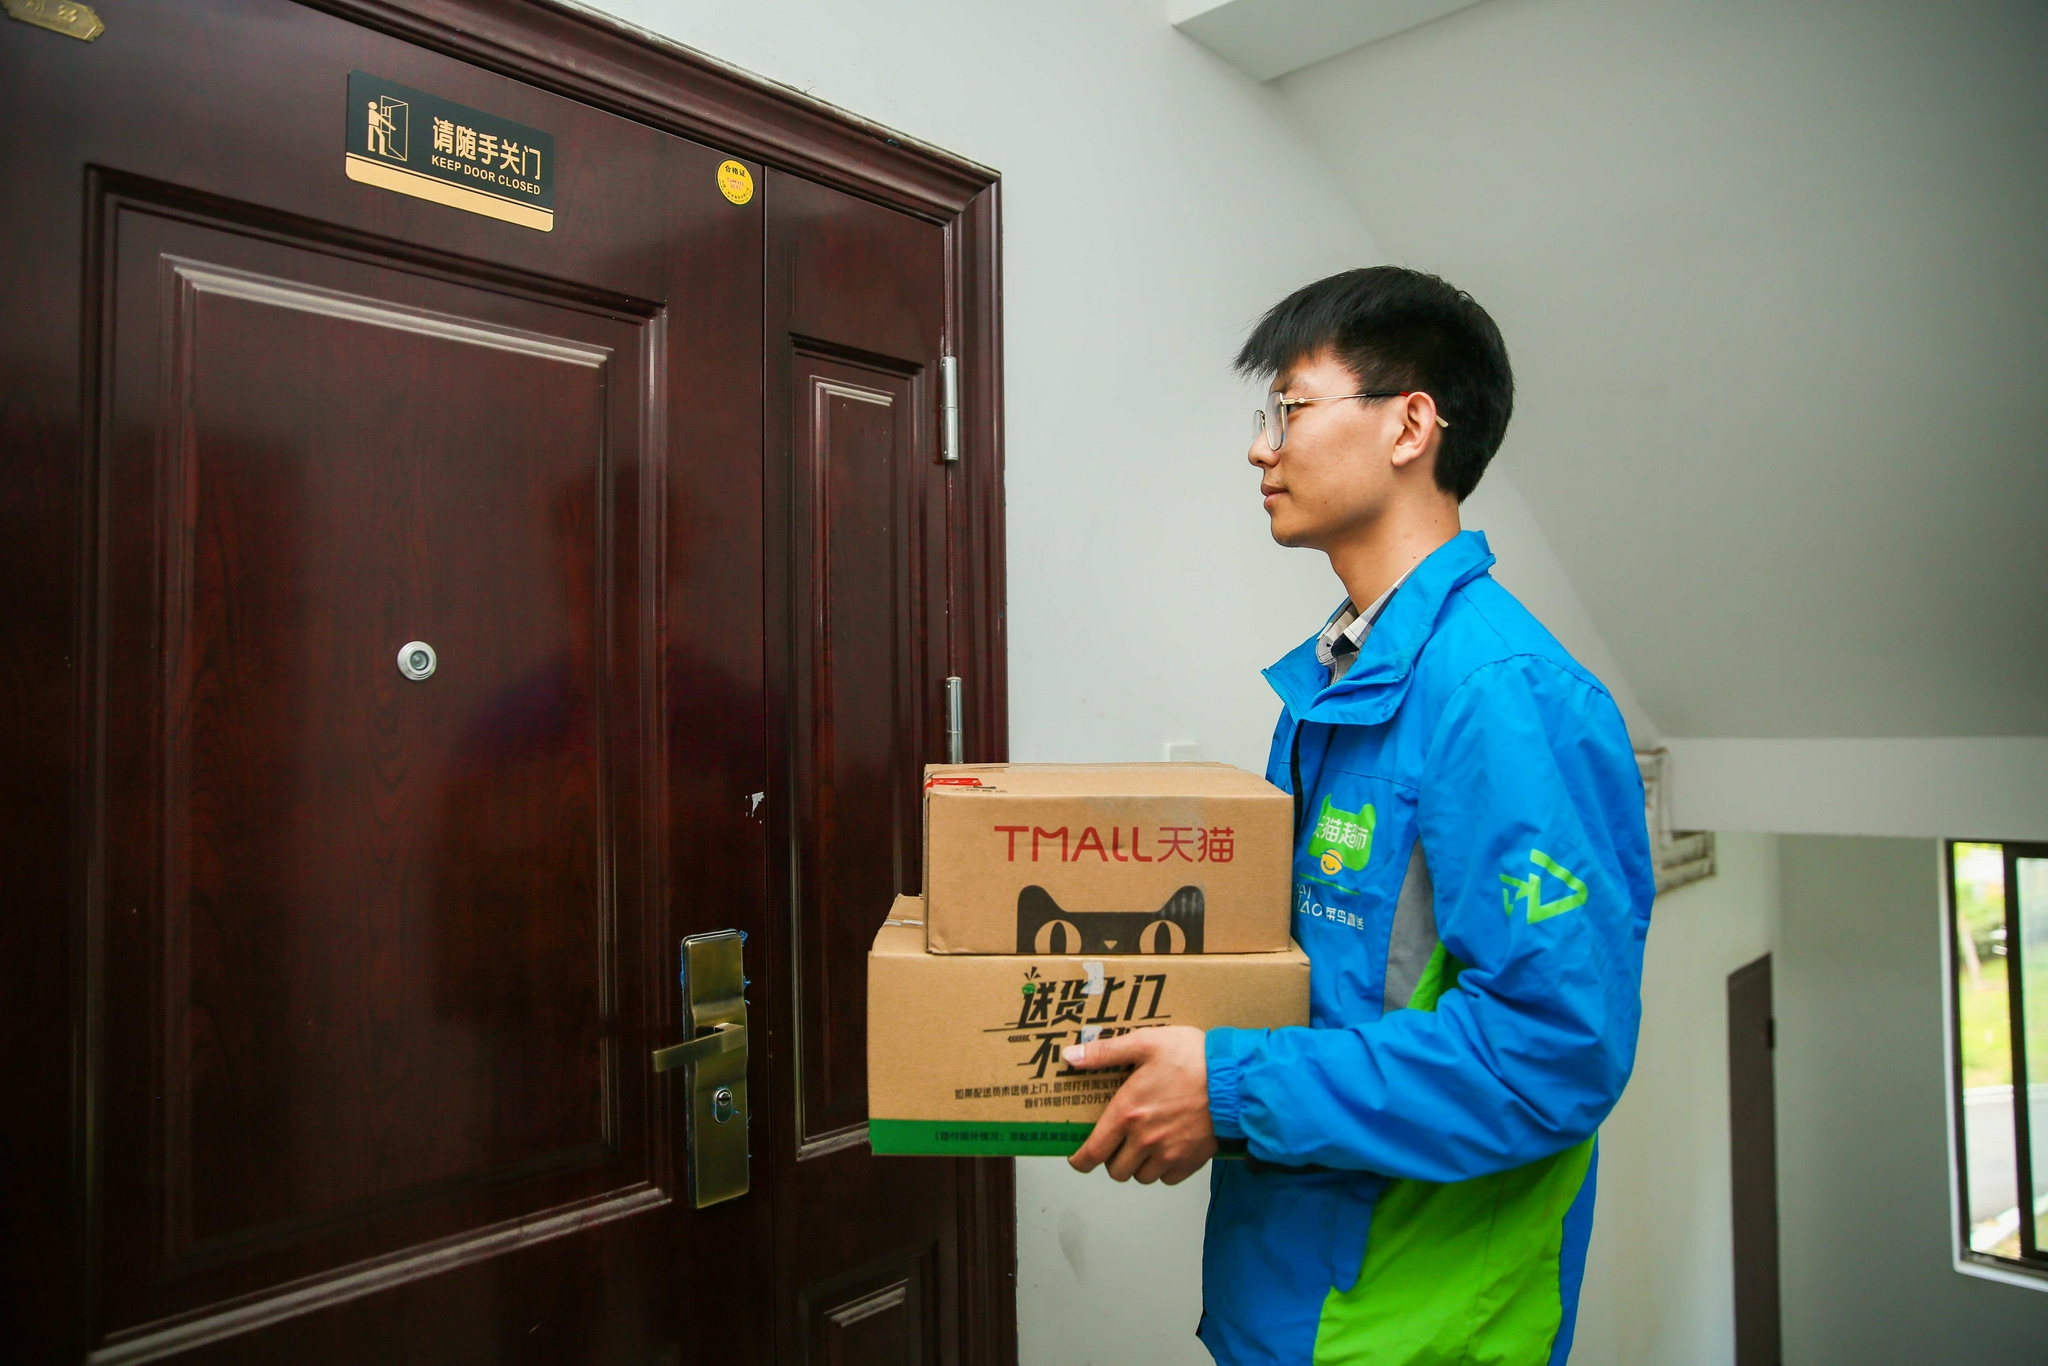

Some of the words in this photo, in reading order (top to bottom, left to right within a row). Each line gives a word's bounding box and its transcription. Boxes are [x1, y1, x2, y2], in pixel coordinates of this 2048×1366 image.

[432, 116, 541, 181] 请随手关门
[725, 165, 746, 178] 合格证
[431, 154, 462, 172] KEEP
[464, 164, 496, 183] DOOR
[498, 174, 541, 196] CLOSED
[990, 973, 1172, 1032] 送货上门
